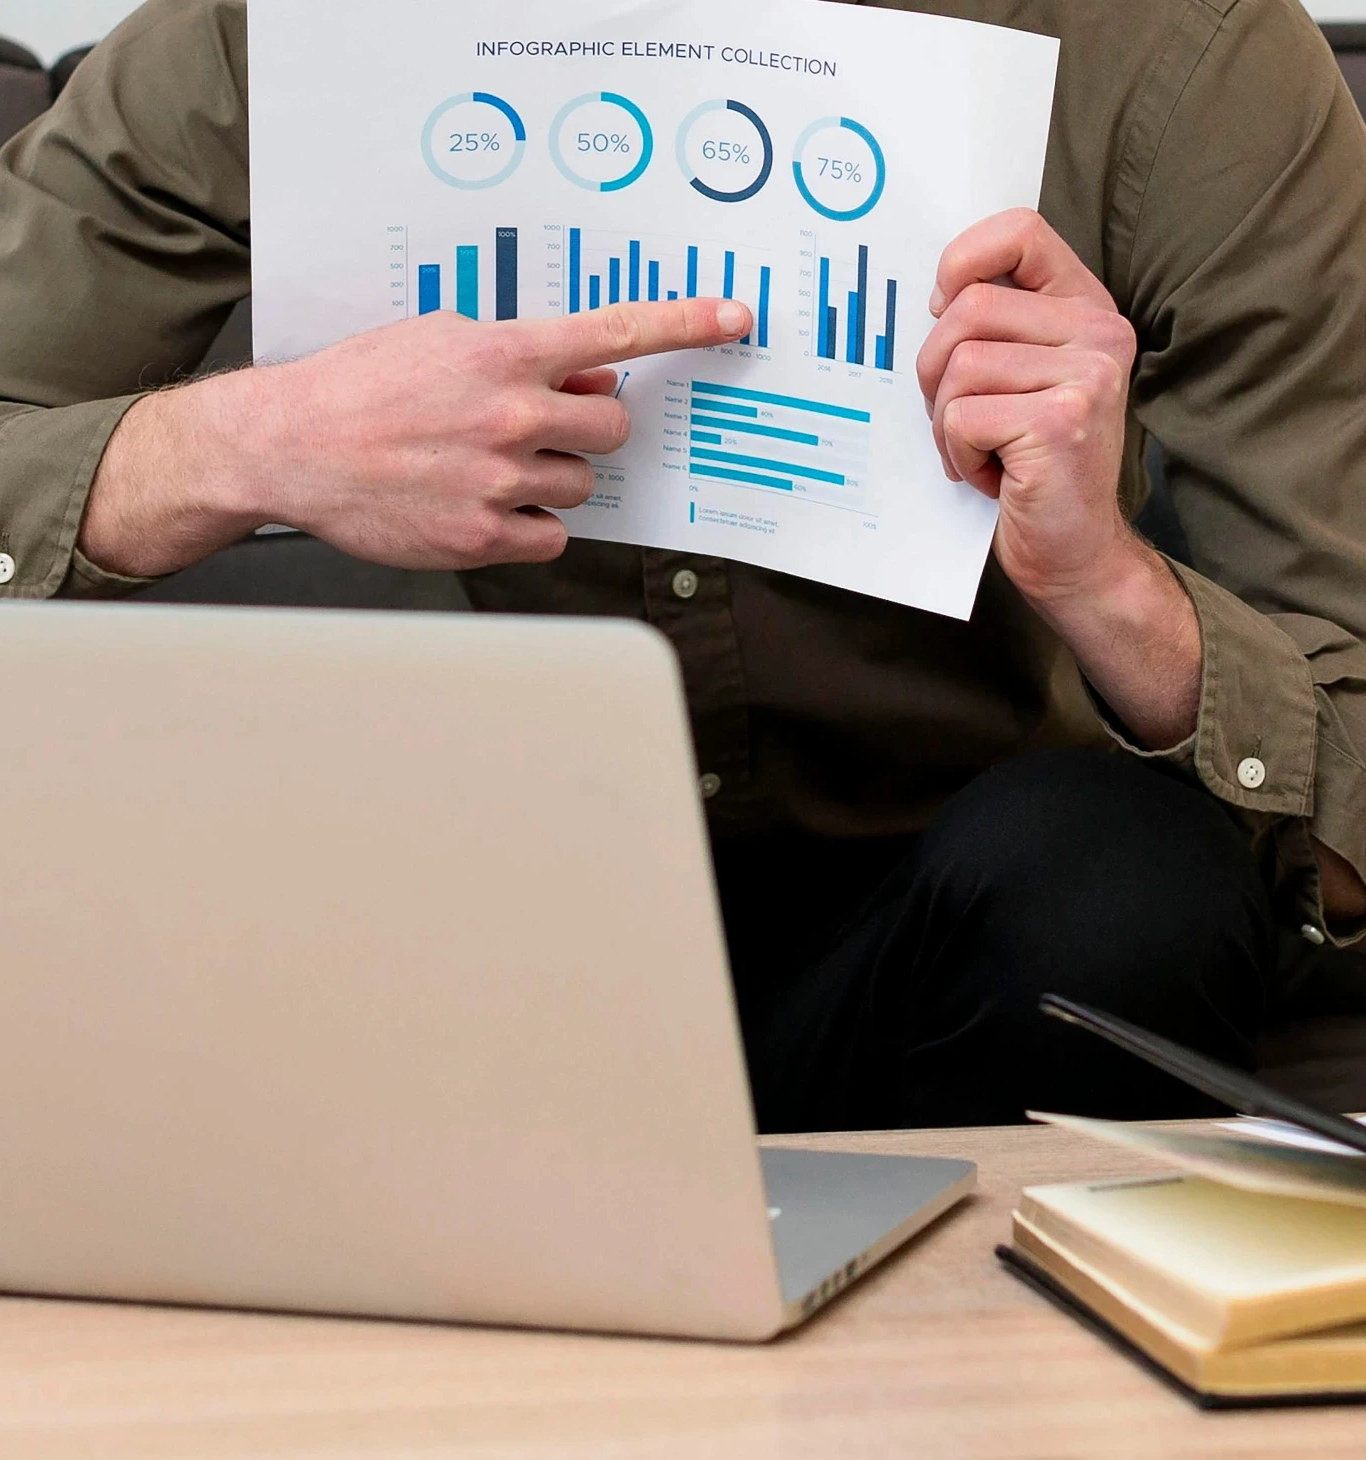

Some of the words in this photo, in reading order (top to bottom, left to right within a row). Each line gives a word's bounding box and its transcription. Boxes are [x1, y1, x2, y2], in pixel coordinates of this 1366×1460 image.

[476, 41, 615, 56] INFOGRAPHIC
[621, 41, 715, 60] ELEMENT
[721, 46, 837, 77] COLLECTION
[449, 132, 500, 152] 25%
[577, 133, 630, 153] 50%
[702, 140, 750, 164] 65%
[817, 157, 862, 183] 75%
[386, 225, 404, 233] 1000
[498, 230, 516, 238] 100%
[799, 250, 813, 258] 900
[799, 269, 812, 278] 700
[798, 289, 811, 298] 500
[391, 299, 405, 307] 100
[798, 329, 810, 337] 100
[738, 350, 752, 358] 900
[756, 353, 772, 361] 1000
[848, 370, 862, 379] 2017
[666, 379, 685, 388] Name
[664, 395, 683, 404] Name
[664, 412, 683, 420] Name
[663, 428, 682, 436] Name
[662, 445, 681, 453] Name
[662, 462, 681, 470] Name
[608, 474, 625, 482] 1000
[698, 507, 719, 516] Lorem
